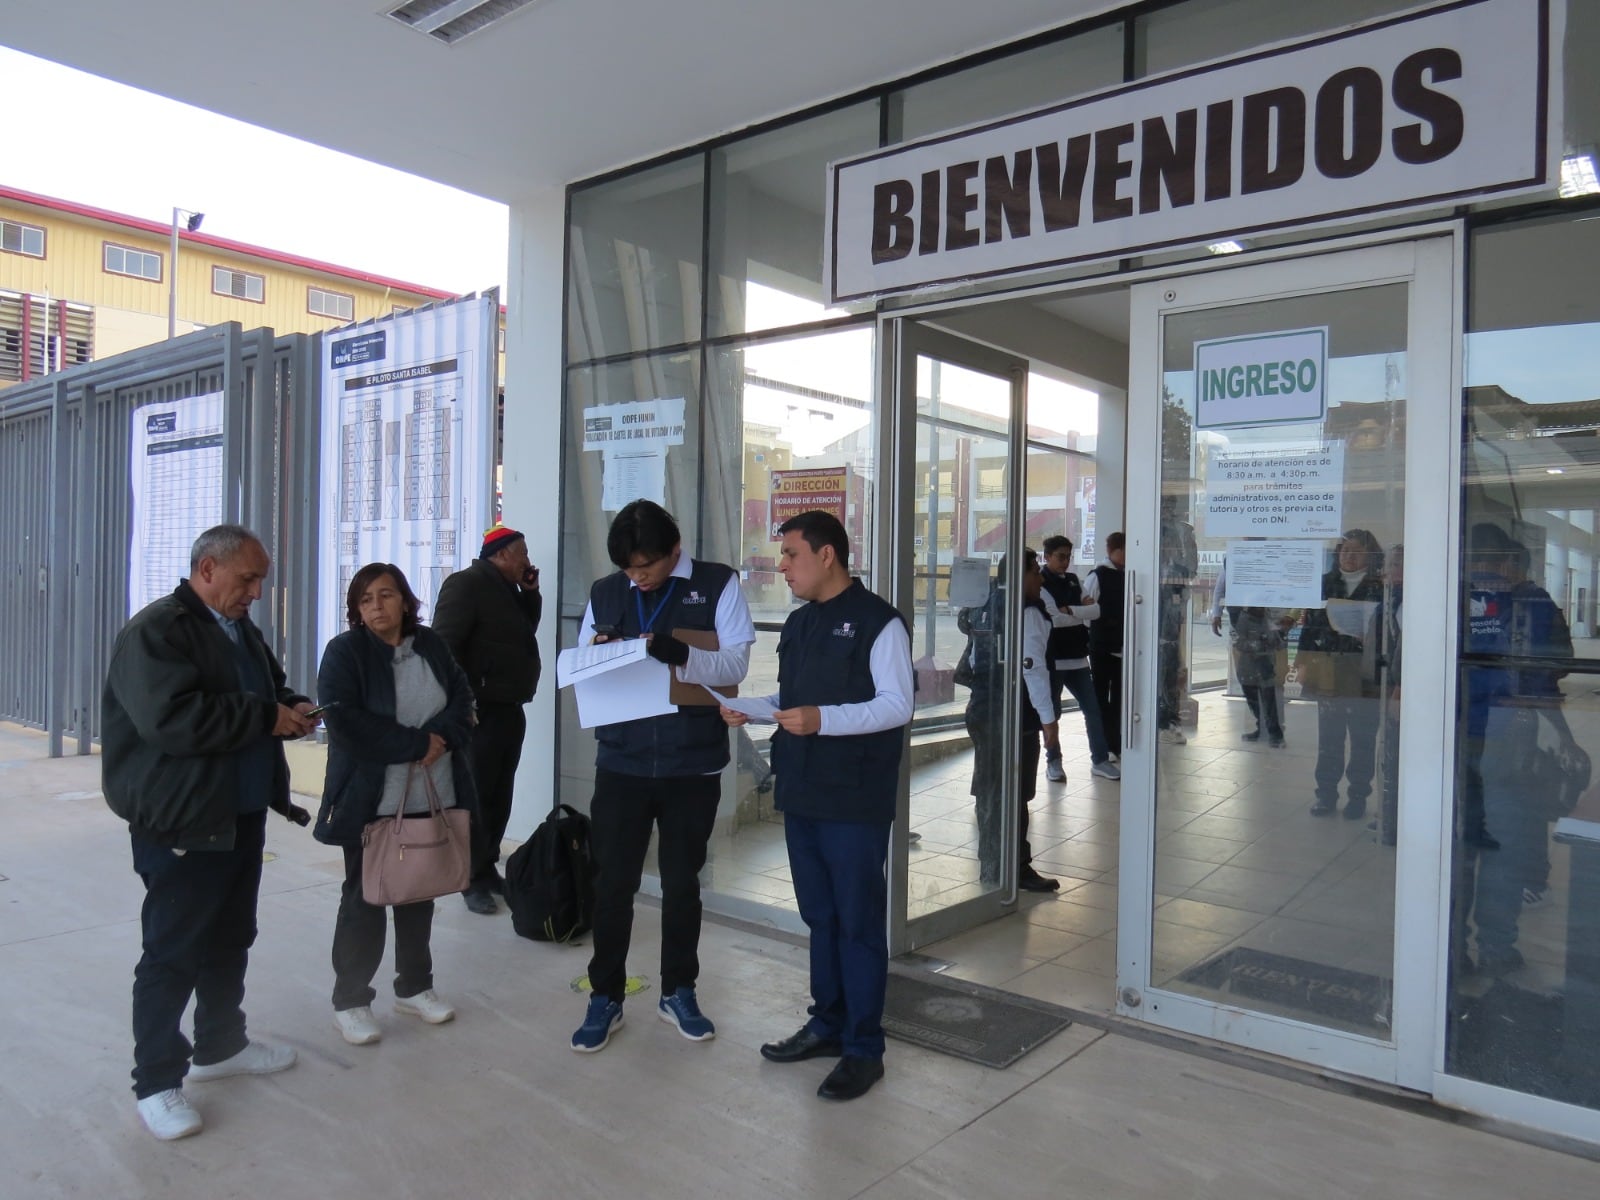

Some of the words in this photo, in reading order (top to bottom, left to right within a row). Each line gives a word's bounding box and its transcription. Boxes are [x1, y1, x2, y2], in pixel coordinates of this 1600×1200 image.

[872, 47, 1464, 265] BIENVENIDOS
[372, 374, 392, 384] PILOTO
[392, 370, 411, 380] SANTA
[411, 366, 432, 376] ISABEL
[1202, 359, 1317, 402] INGRESO
[1218, 459, 1249, 469] horario
[1251, 458, 1262, 468] de
[1264, 458, 1304, 467] atención
[1320, 458, 1332, 466] de
[1226, 471, 1246, 480] 8:30
[1247, 471, 1266, 479] a.m.
[783, 478, 840, 491] DIRECCIÓN
[1243, 484, 1264, 493] para
[1265, 481, 1303, 491] trámites
[774, 497, 801, 505] HORARIO
[812, 495, 842, 504] ATENCIÓN
[1212, 494, 1282, 503] administrativos,
[1297, 493, 1321, 501] caso
[1323, 492, 1334, 501] de
[776, 508, 800, 517] LUNES
[1239, 506, 1245, 515] y
[1246, 505, 1270, 513] otros
[1284, 504, 1314, 514] previa
[1316, 503, 1337, 513] cita,
[1251, 516, 1268, 524] con
[1270, 515, 1290, 524] DNI.
